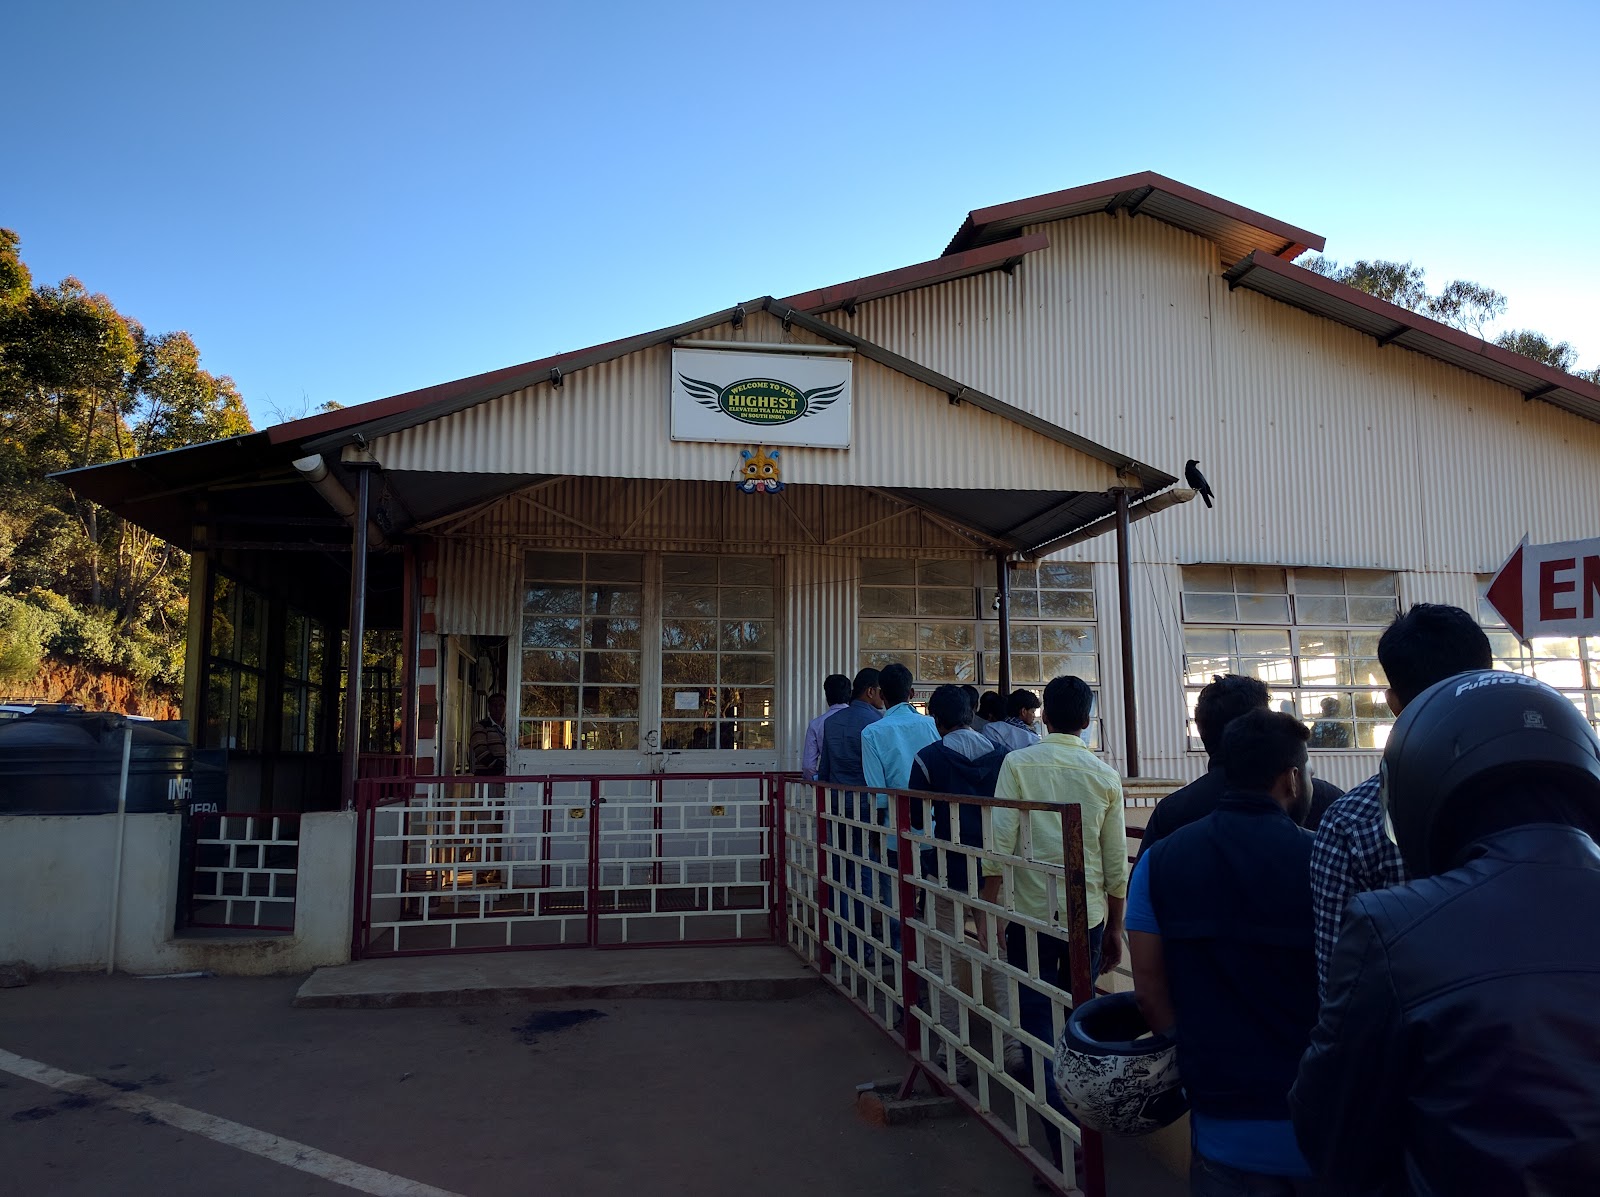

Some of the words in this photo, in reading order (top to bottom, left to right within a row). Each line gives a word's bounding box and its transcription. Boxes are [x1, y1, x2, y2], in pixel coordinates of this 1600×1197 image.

[731, 382, 768, 395] WELCOME
[781, 387, 796, 398] THE
[728, 395, 799, 409] HIGHEST
